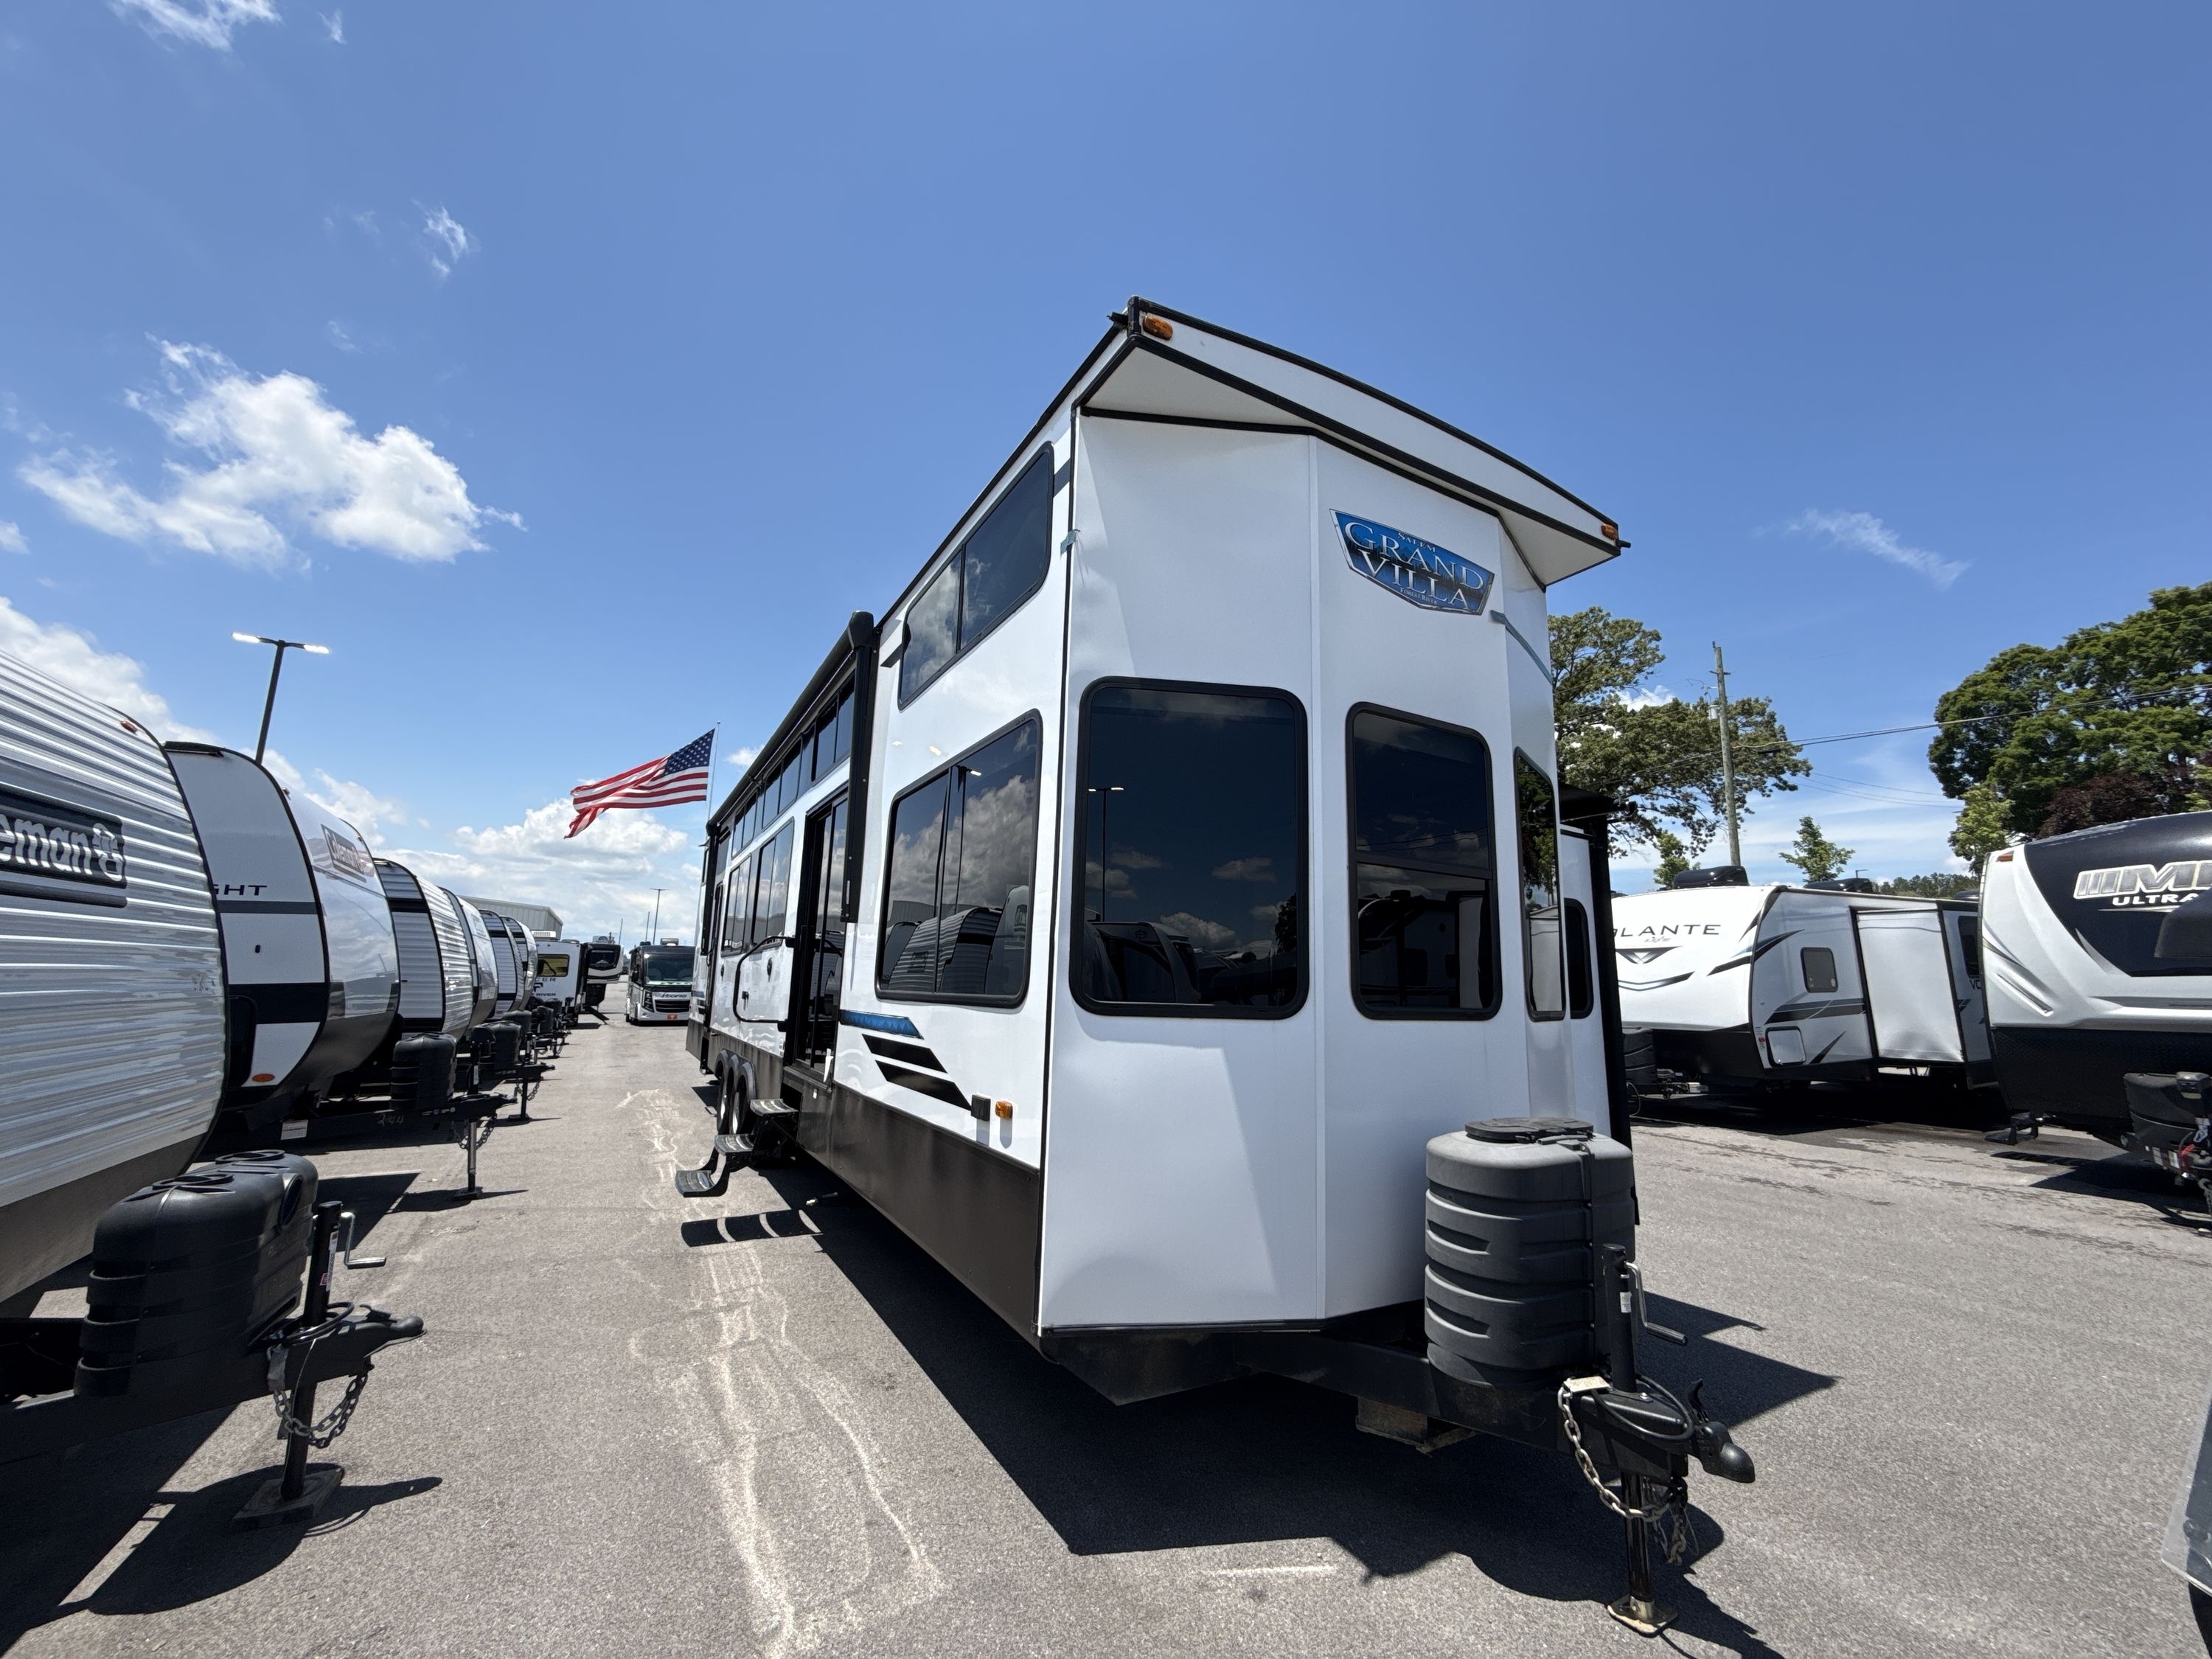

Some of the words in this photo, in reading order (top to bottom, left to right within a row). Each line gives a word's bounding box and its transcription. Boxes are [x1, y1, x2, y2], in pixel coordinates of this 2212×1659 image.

[1345, 522, 1484, 590] GRAND
[1397, 532, 1437, 553] SALEM
[1358, 549, 1474, 611] VILLA
[1400, 587, 1422, 599] FOREST
[1422, 594, 1438, 605] RIVER
